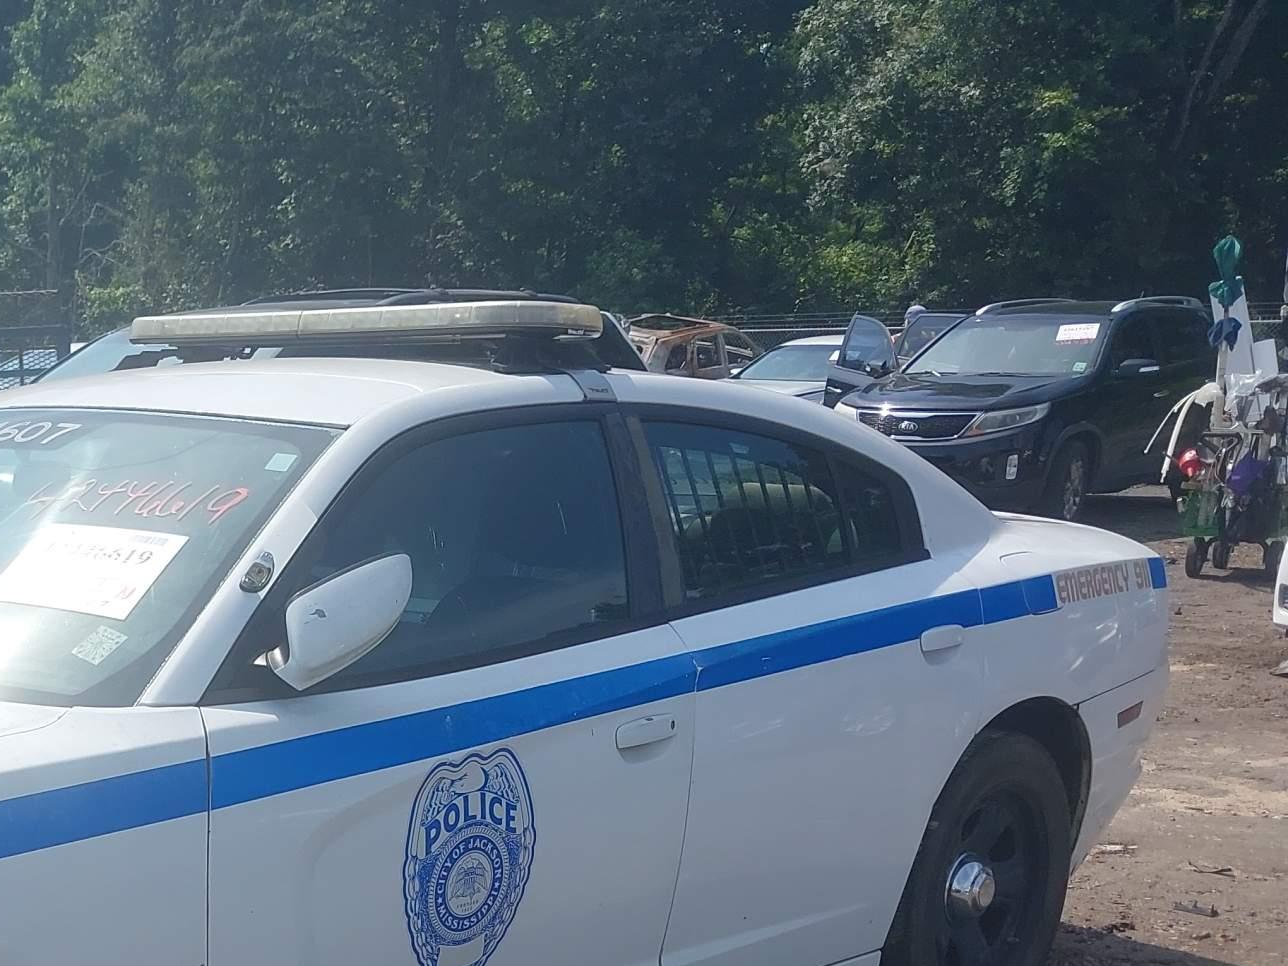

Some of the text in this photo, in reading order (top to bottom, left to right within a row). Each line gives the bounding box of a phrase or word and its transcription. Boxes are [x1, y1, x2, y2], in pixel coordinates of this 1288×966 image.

[425, 791, 518, 857] POLICE
[437, 838, 502, 894] CITY OF JACKSON
[438, 890, 498, 930] MISSISSIPPI
